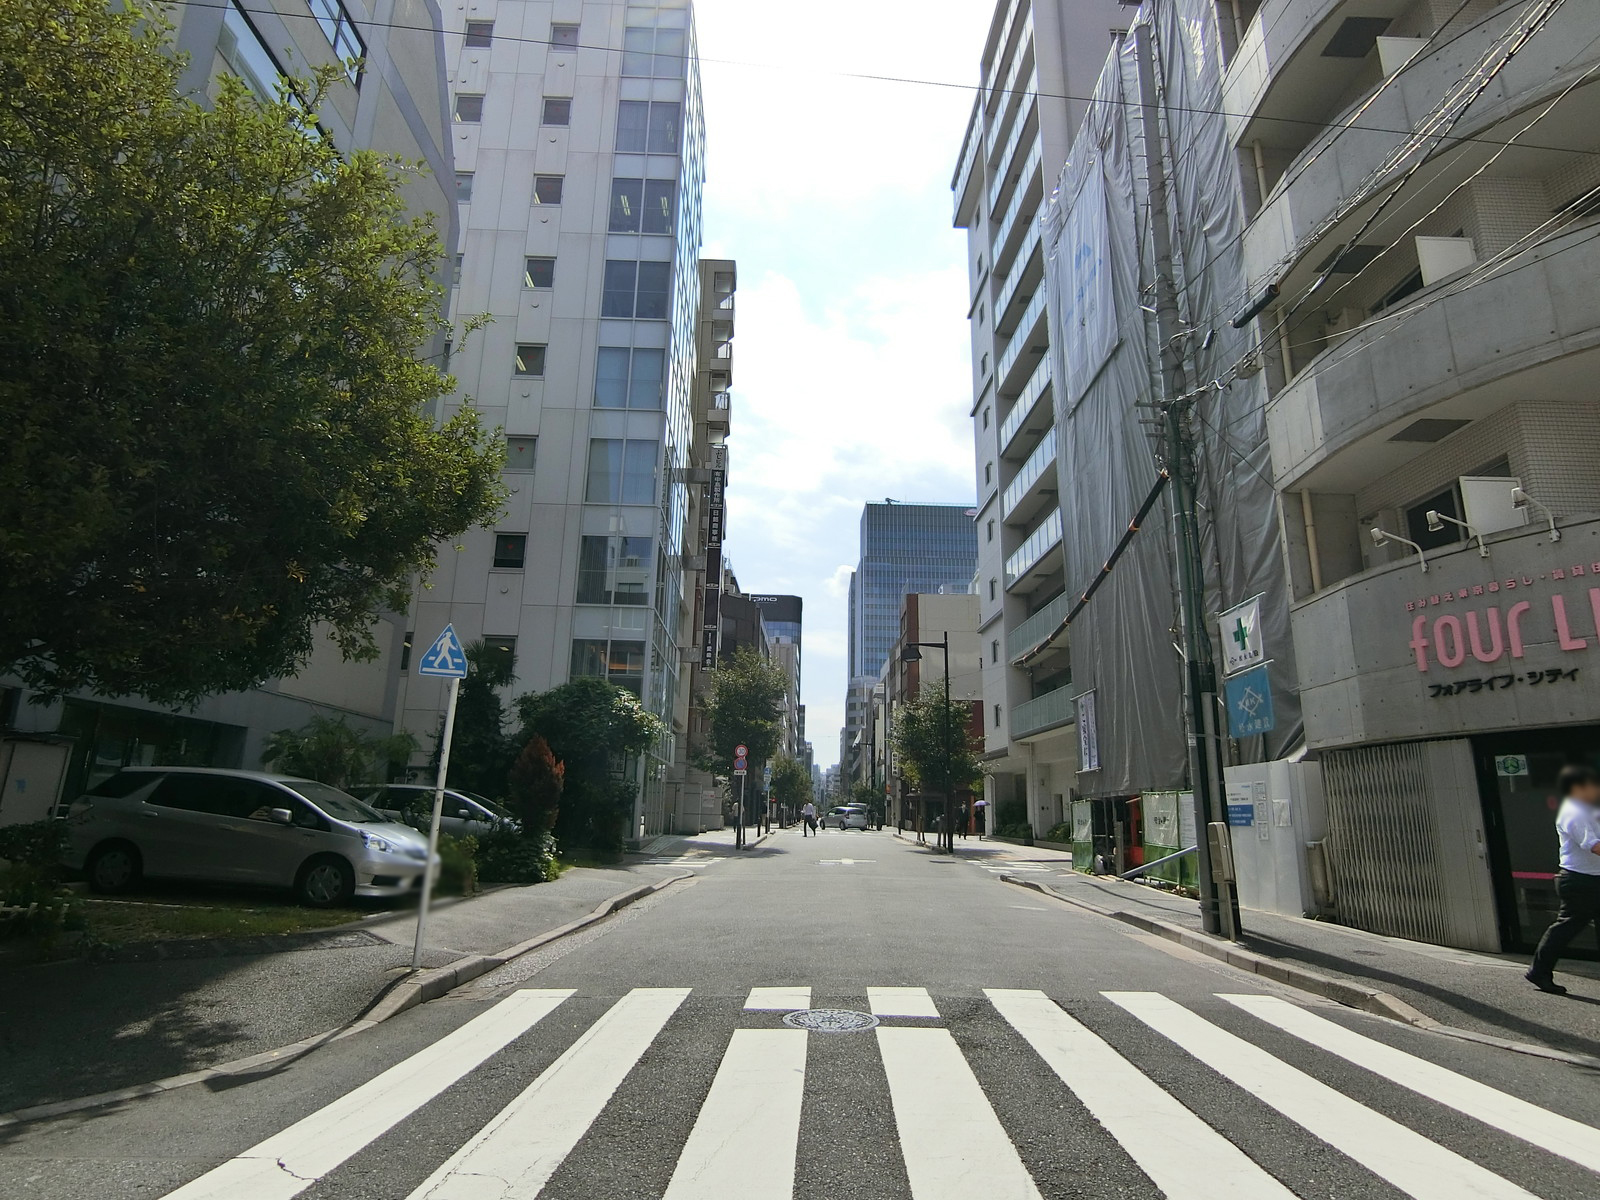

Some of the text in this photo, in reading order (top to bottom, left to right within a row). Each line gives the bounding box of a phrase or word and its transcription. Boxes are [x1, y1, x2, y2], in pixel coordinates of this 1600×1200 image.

[1428, 668, 1579, 698] フォアライフ・シティ
